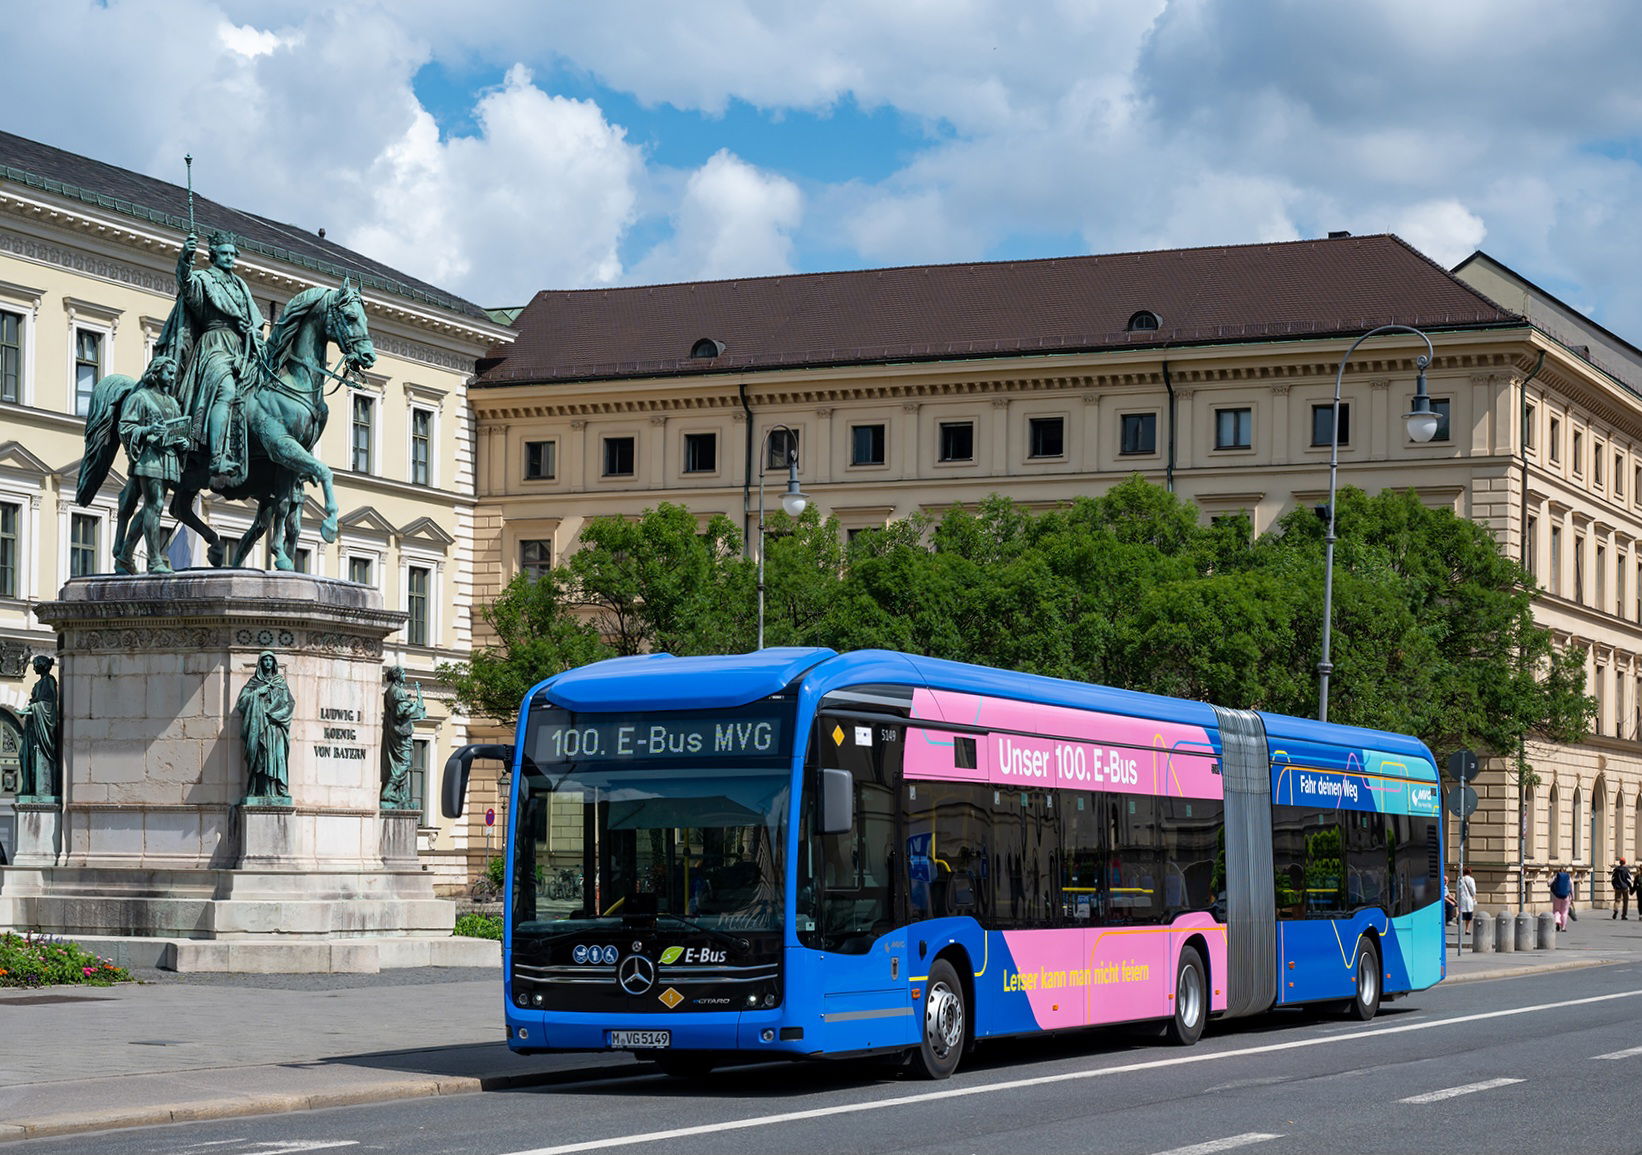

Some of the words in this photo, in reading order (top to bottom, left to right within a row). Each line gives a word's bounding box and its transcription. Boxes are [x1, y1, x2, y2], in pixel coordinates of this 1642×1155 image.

[320, 708, 354, 721] LUDWIG
[324, 728, 356, 740] KOENIG
[552, 729, 605, 756] 100.
[618, 726, 702, 754] E-Bus
[715, 722, 772, 751] MVG
[881, 729, 896, 741] 5149
[314, 746, 330, 757] VON
[334, 747, 366, 759] BAYERN
[999, 738, 1049, 777] Unser
[1056, 744, 1091, 781] 100.
[1094, 748, 1138, 784] E-Bus
[1300, 775, 1316, 794] Fahr
[1318, 776, 1342, 796] deinen
[1343, 779, 1358, 802] Weg
[685, 948, 726, 962] E-Bus
[1003, 966, 1038, 992] Leiser
[1041, 966, 1066, 989] kann
[1069, 969, 1091, 987] man
[1094, 961, 1119, 984] nicht
[1122, 959, 1149, 982] feiern
